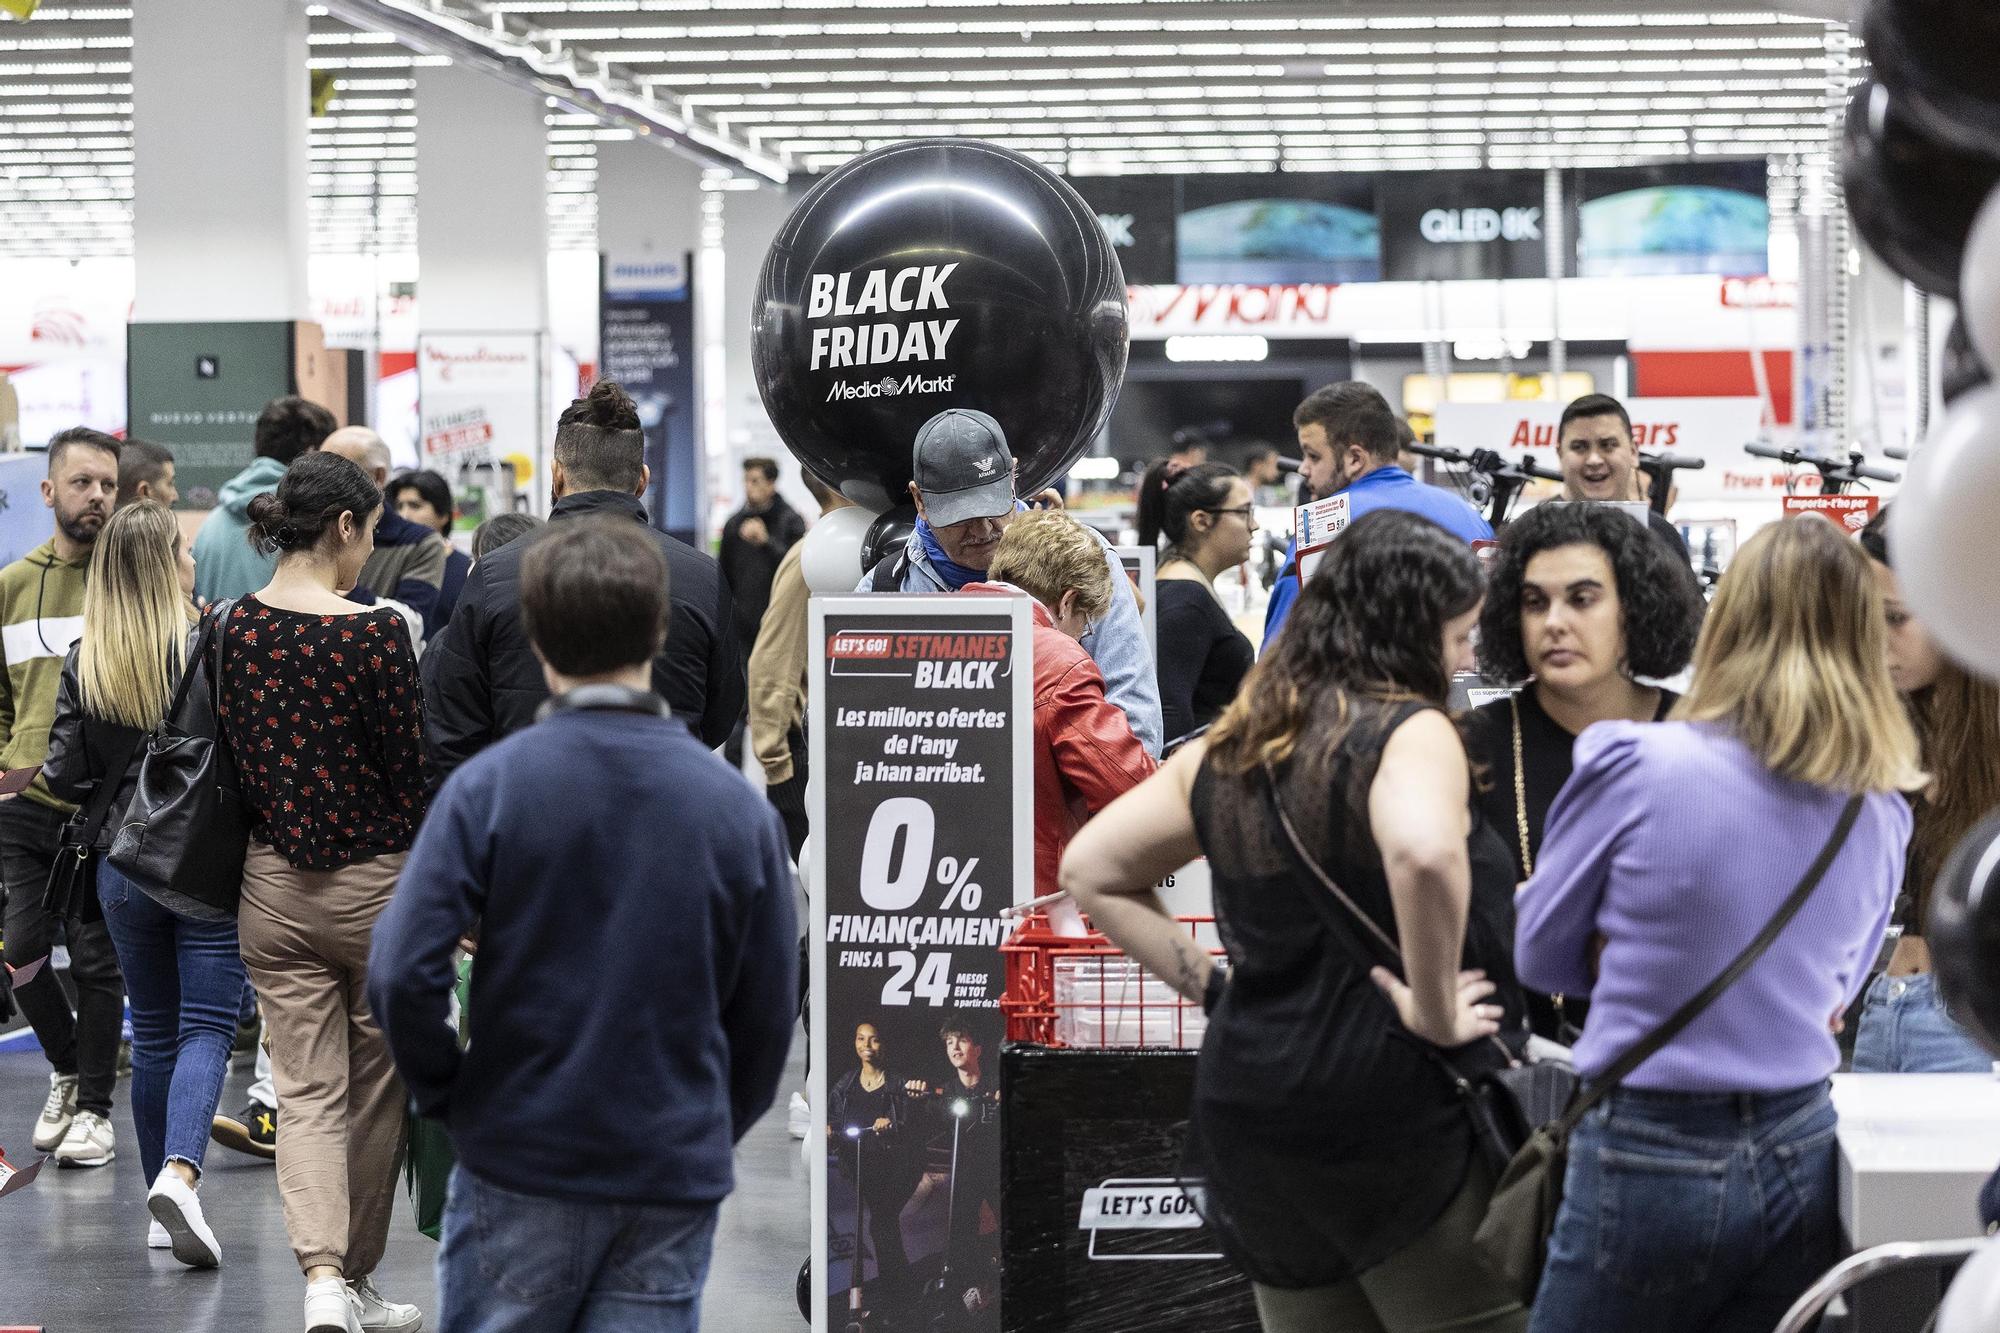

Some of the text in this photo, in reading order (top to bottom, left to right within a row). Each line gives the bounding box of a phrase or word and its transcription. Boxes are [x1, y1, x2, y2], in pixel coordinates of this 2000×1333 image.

[807, 262, 959, 319] BLACK
[810, 319, 960, 371] FRIDAY
[205, 411, 259, 424] VERTU
[834, 635, 1008, 659] LET'S GO! SETMANES
[914, 661, 998, 689] BLACK
[836, 707, 1006, 728] Les millors ofertes
[884, 734, 958, 759] de l'any
[854, 761, 985, 785] ja han arribat.
[827, 915, 1013, 950] FINANÇAMENT
[839, 950, 952, 1007] FINS A 24
[955, 973, 988, 985] MESOS
[954, 986, 987, 997] EN TOT
[954, 999, 960, 1008] a
[959, 999, 982, 1008] partir
[981, 999, 992, 1008] de
[1101, 1195, 1153, 1215] LET'S
